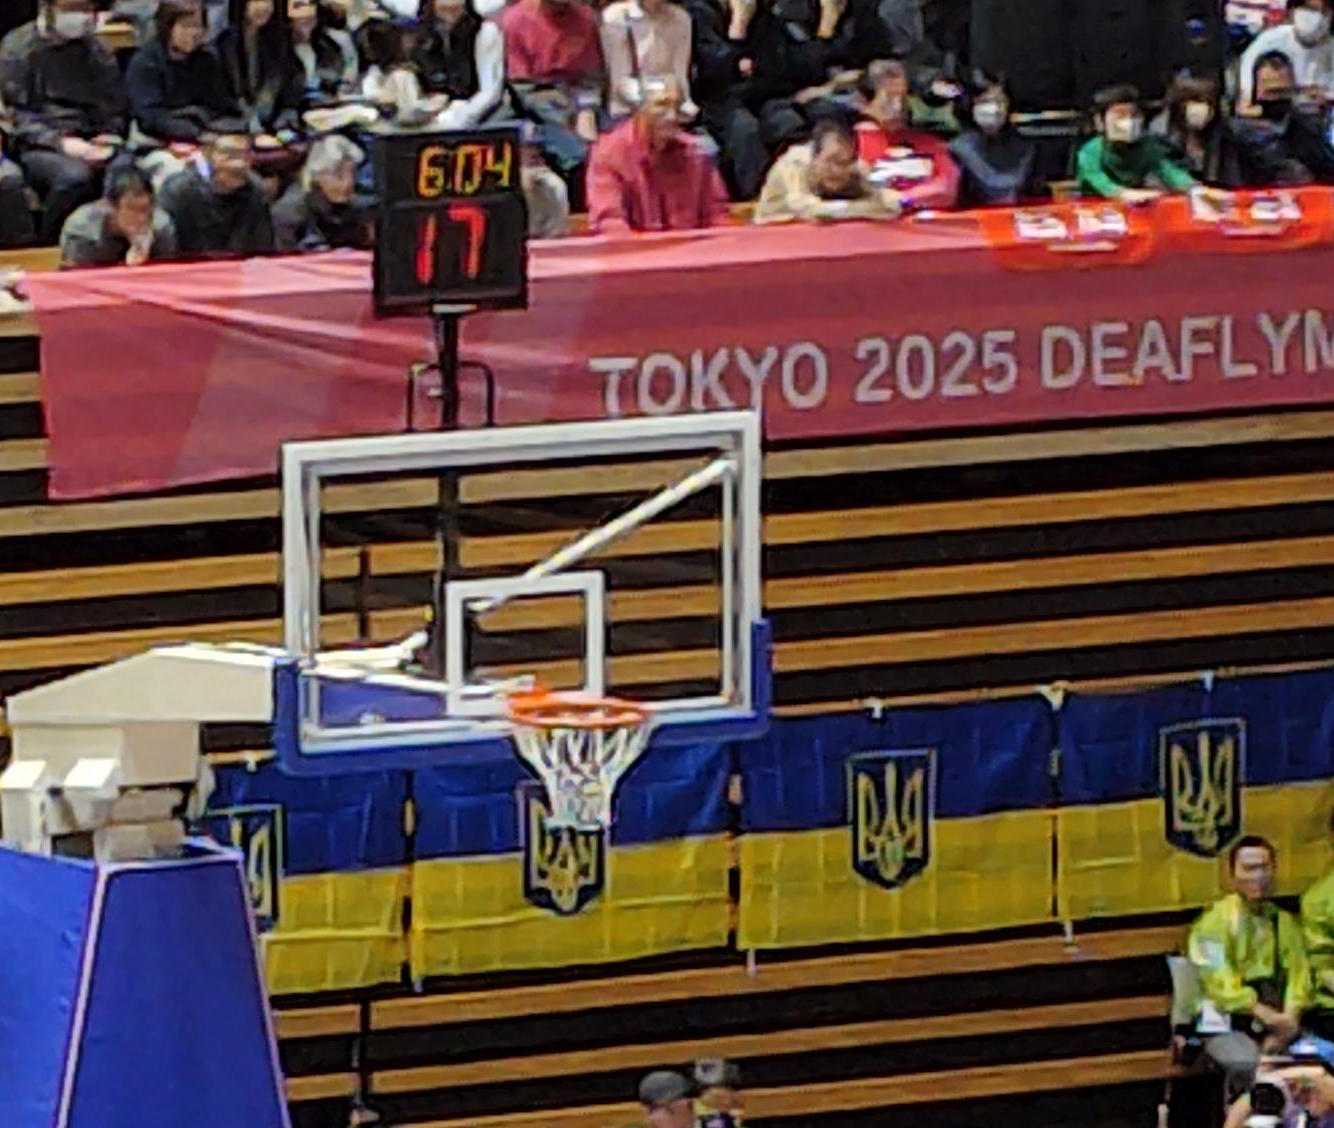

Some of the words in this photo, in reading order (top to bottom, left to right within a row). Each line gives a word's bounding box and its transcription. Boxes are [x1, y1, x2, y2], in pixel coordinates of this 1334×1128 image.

[415, 203, 487, 285] 17
[588, 340, 829, 419] TOKYO
[853, 329, 1020, 404] 2025
